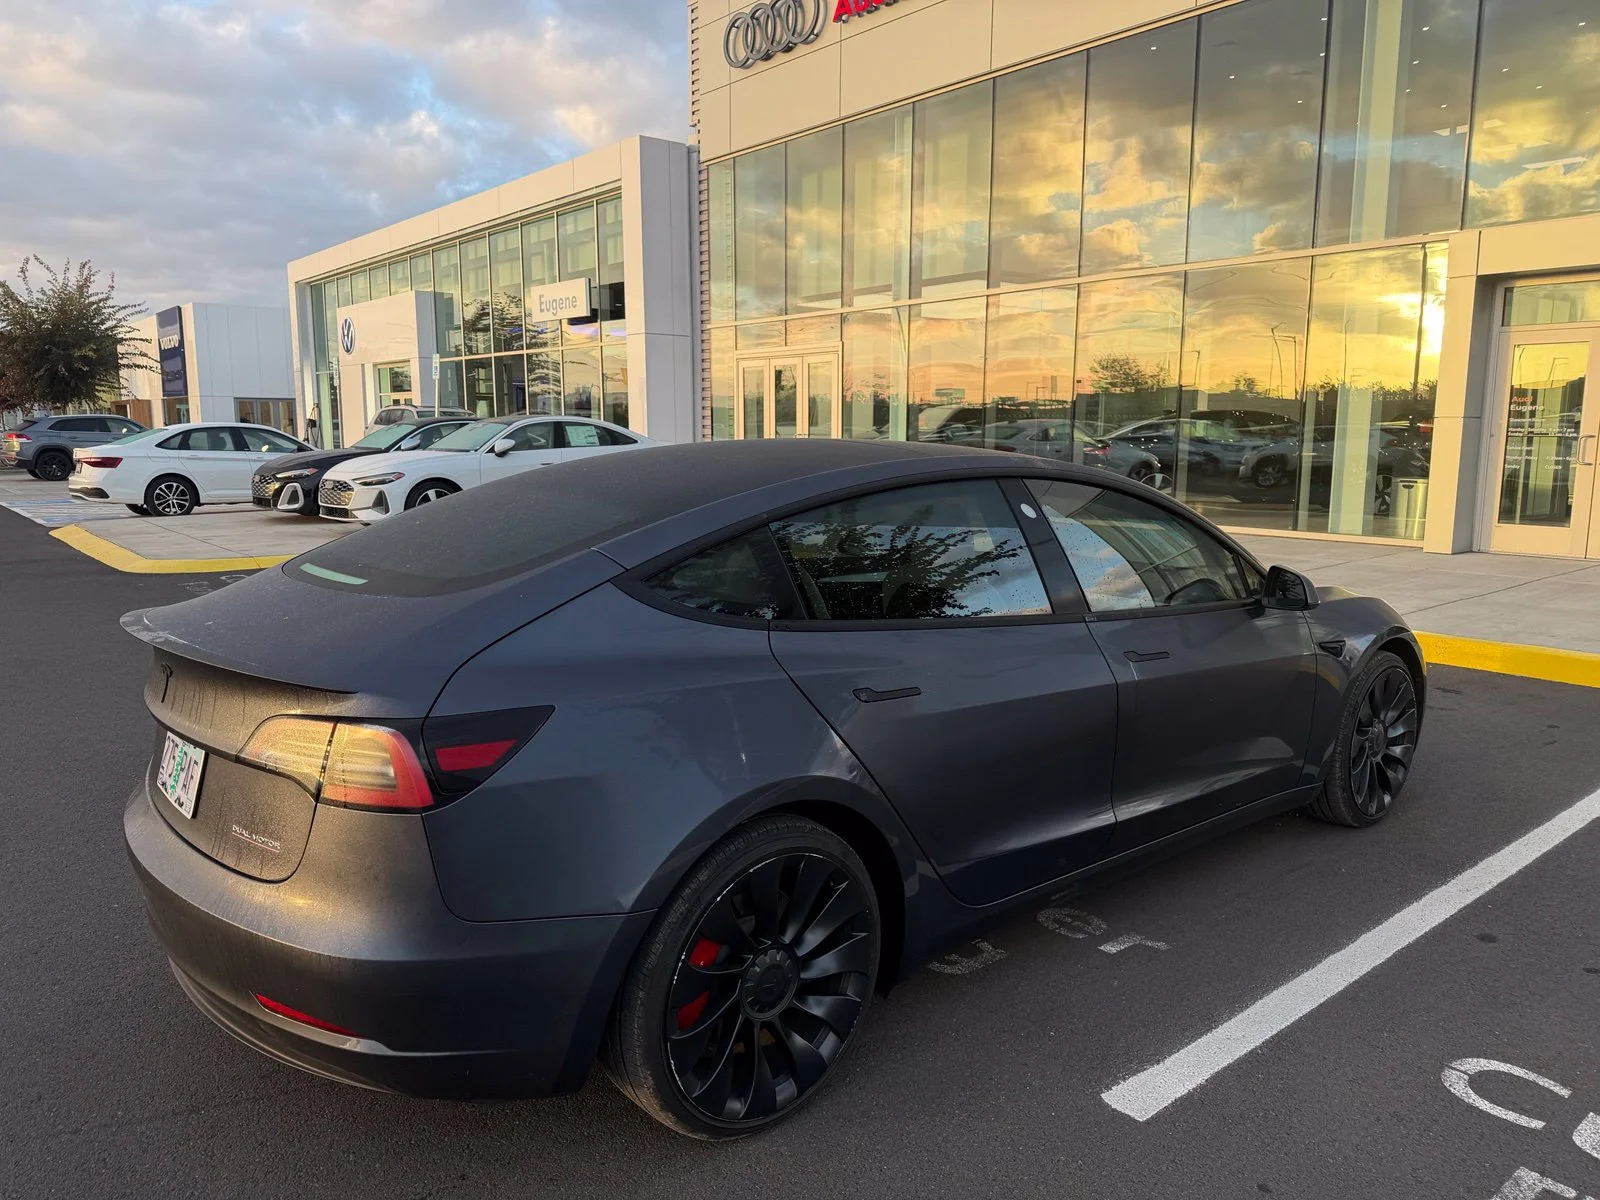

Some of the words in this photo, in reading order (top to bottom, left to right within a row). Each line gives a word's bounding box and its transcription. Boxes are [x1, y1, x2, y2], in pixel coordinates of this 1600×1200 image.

[538, 294, 578, 317] Eugene
[160, 334, 179, 350] VOLVO
[232, 824, 251, 839] DUAL
[252, 834, 281, 850] MOTOR
